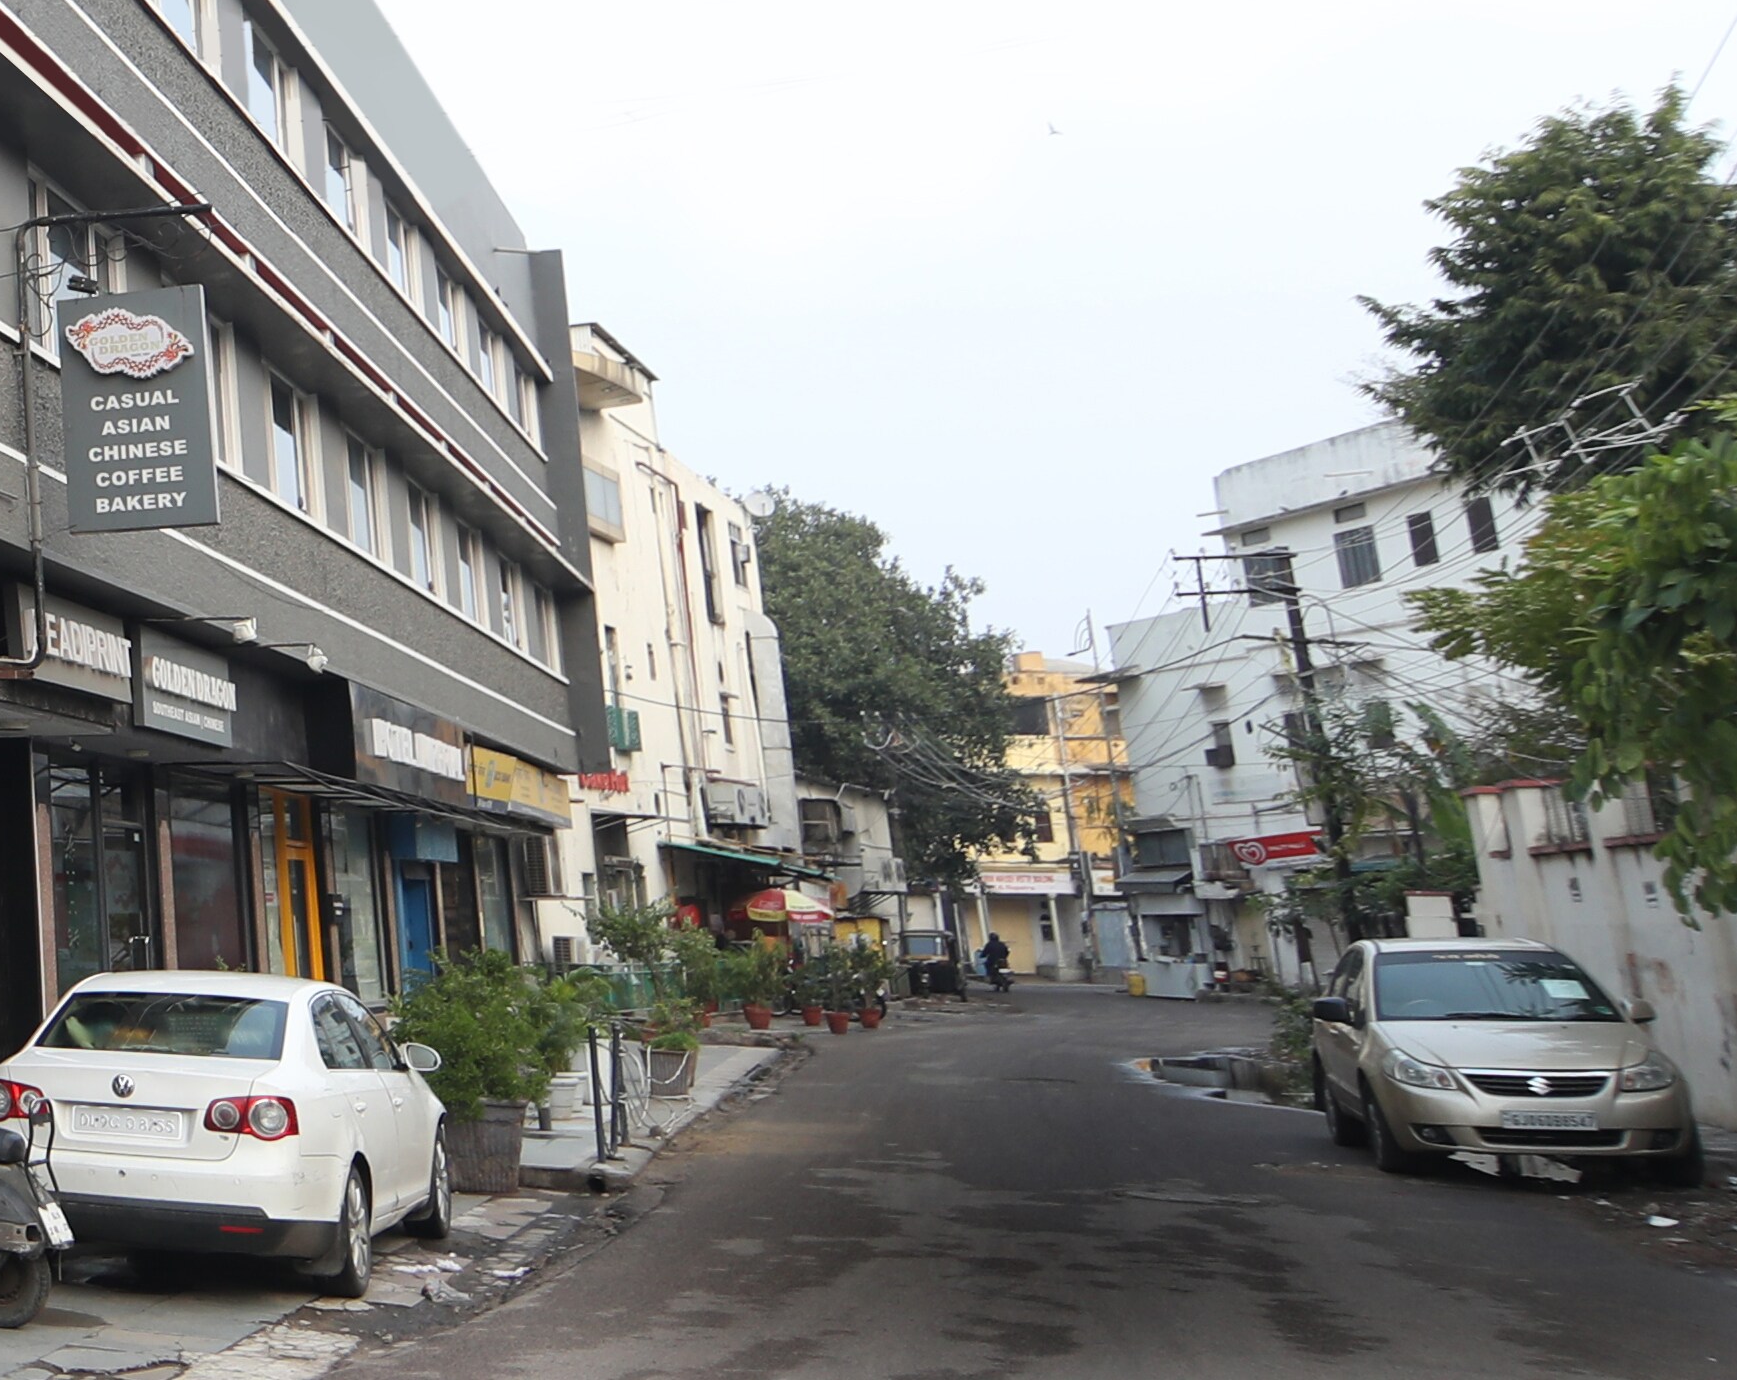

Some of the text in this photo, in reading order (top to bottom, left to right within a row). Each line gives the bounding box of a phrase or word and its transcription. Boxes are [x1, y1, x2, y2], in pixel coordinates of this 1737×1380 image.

[89, 333, 148, 347] GOLDEN
[99, 341, 162, 355] DRAGON
[90, 389, 180, 411] CASUAL
[101, 415, 171, 436] ASIAN
[88, 439, 188, 462] CHINESE
[96, 466, 184, 488] COFFEE
[96, 491, 187, 514] BAKERY
[24, 608, 132, 678] EADIPRINT
[152, 655, 237, 712] GOLDEN DRAGON
[152, 701, 185, 722] SOUTHEAST
[185, 710, 201, 726] ASIAN
